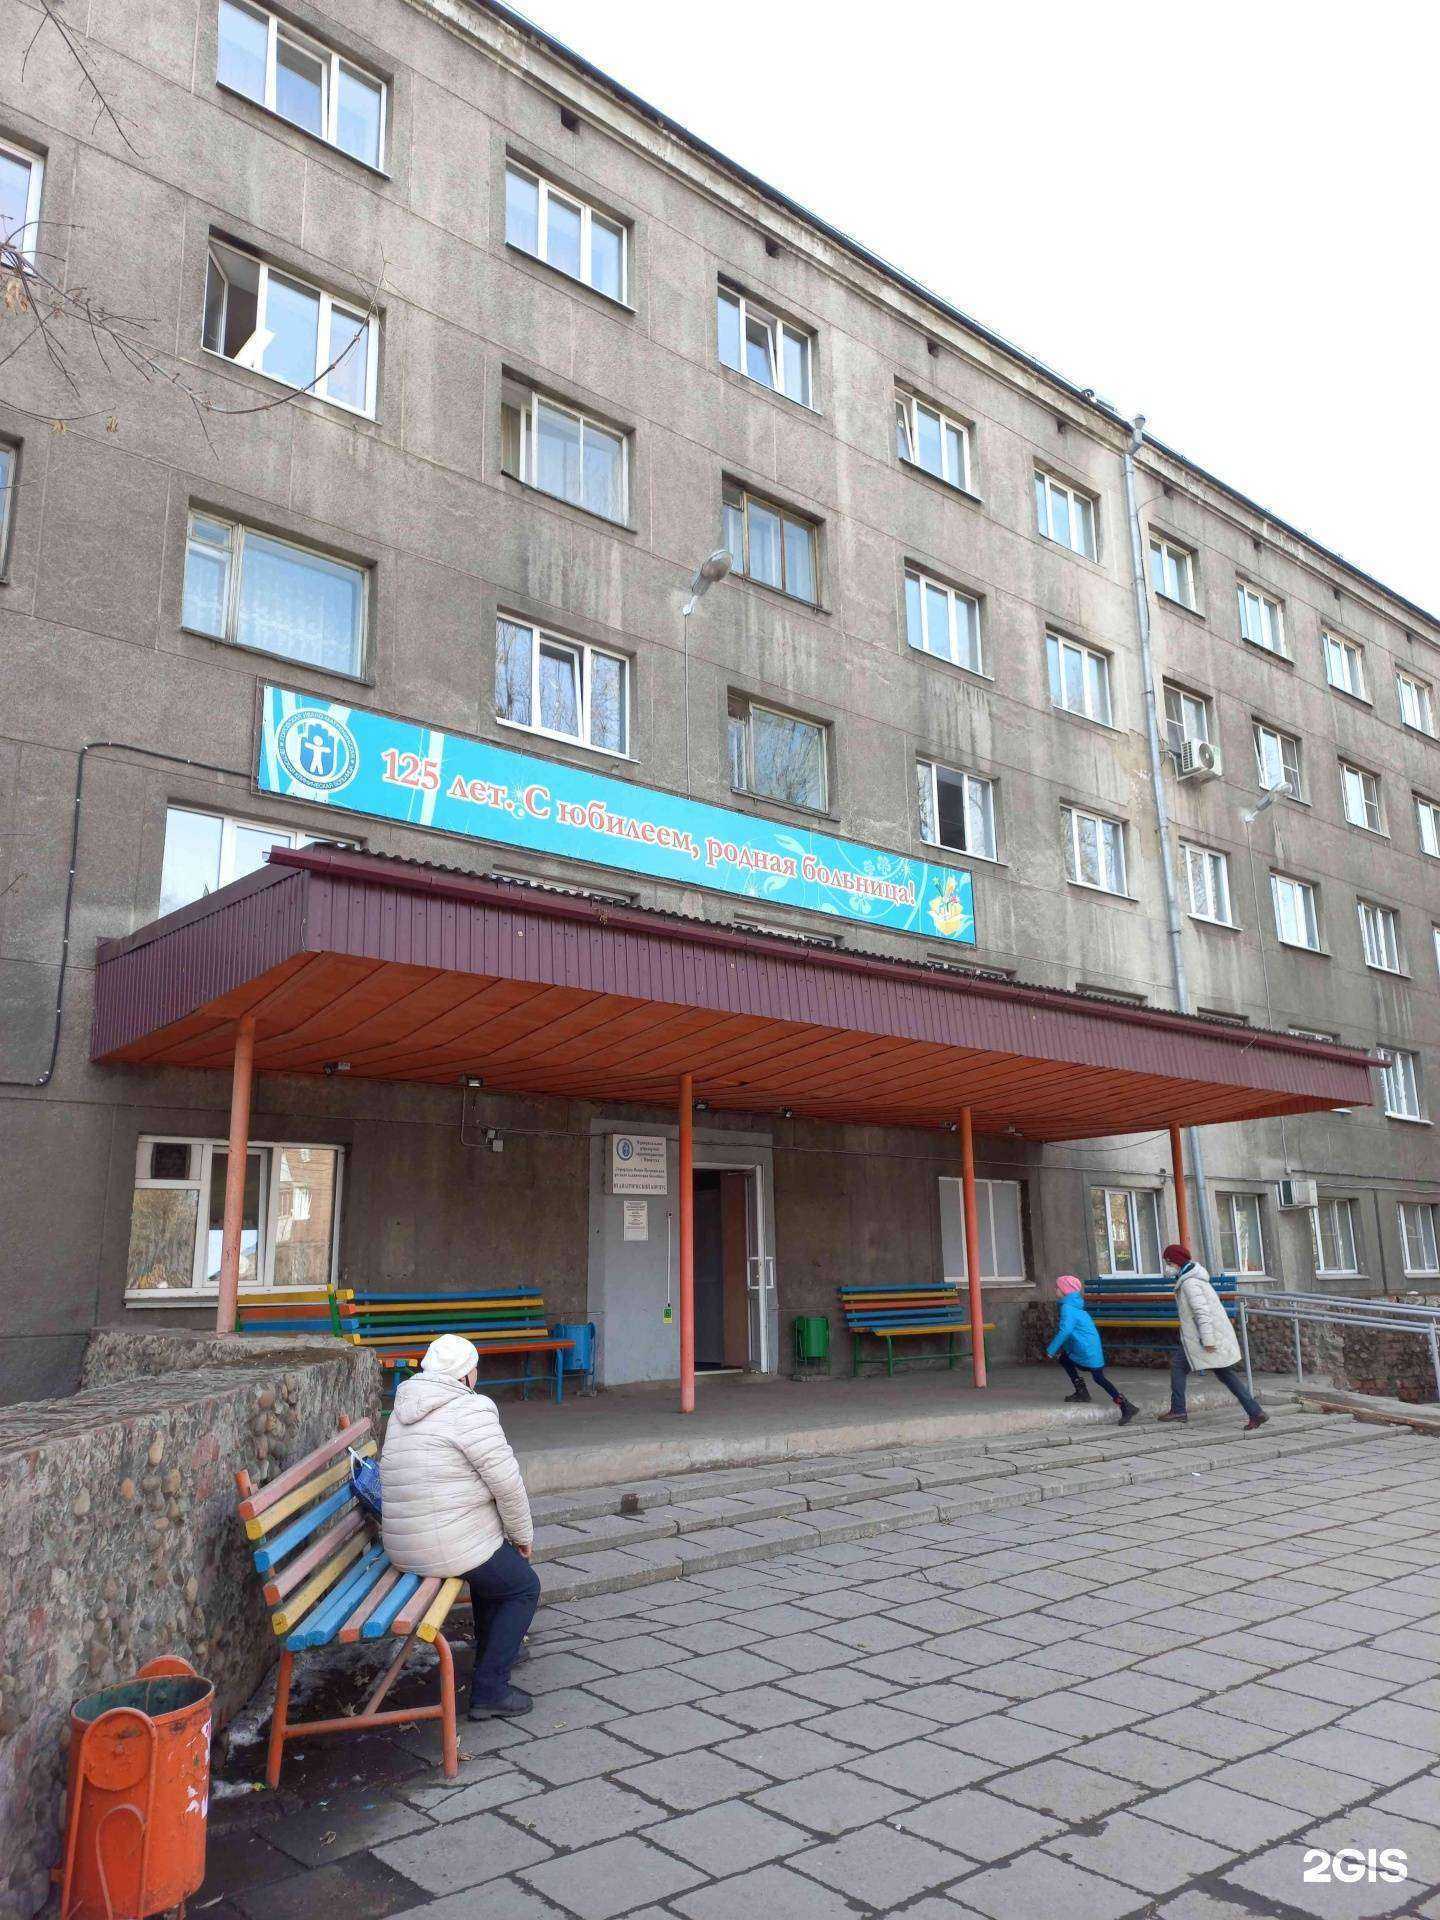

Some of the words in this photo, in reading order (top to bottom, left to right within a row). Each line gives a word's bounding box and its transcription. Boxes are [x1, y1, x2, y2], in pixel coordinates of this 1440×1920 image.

[382, 750, 440, 790] 125
[448, 776, 514, 809] лет.
[525, 786, 550, 817] С
[558, 802, 700, 859] юбилеем,
[706, 838, 796, 876] родная
[803, 855, 915, 905] больница!
